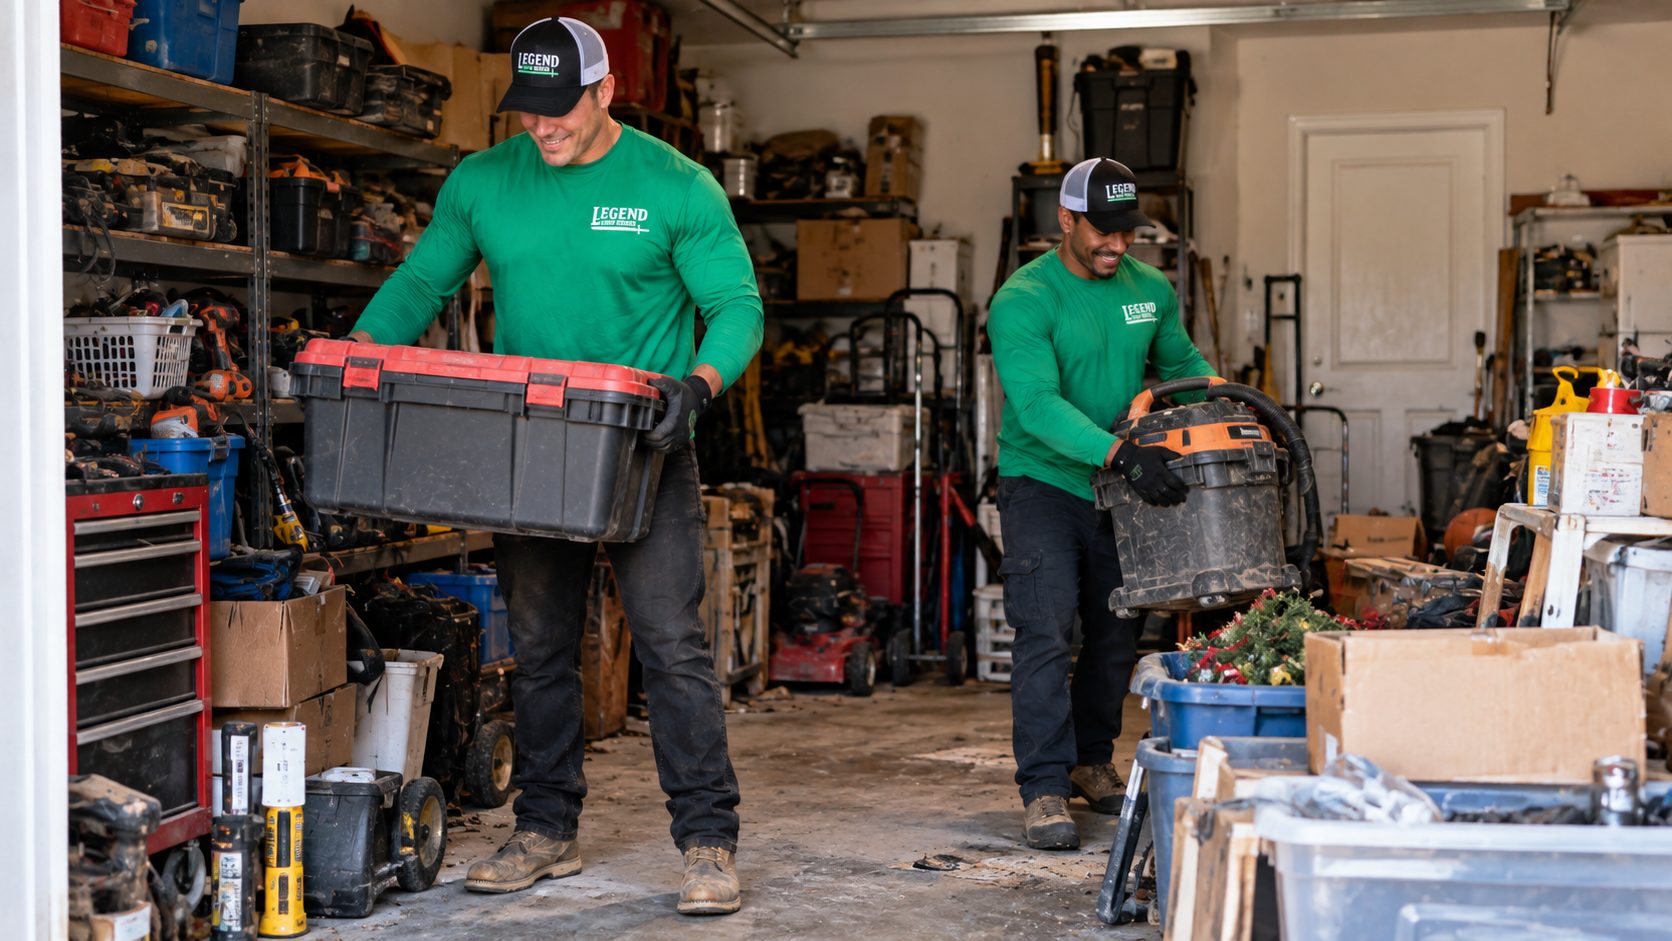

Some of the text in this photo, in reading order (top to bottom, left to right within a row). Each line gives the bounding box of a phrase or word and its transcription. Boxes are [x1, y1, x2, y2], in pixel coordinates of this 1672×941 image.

[518, 52, 560, 69] LEGEND
[590, 206, 649, 226] LEGEND
[1121, 302, 1157, 321] LEGEND
